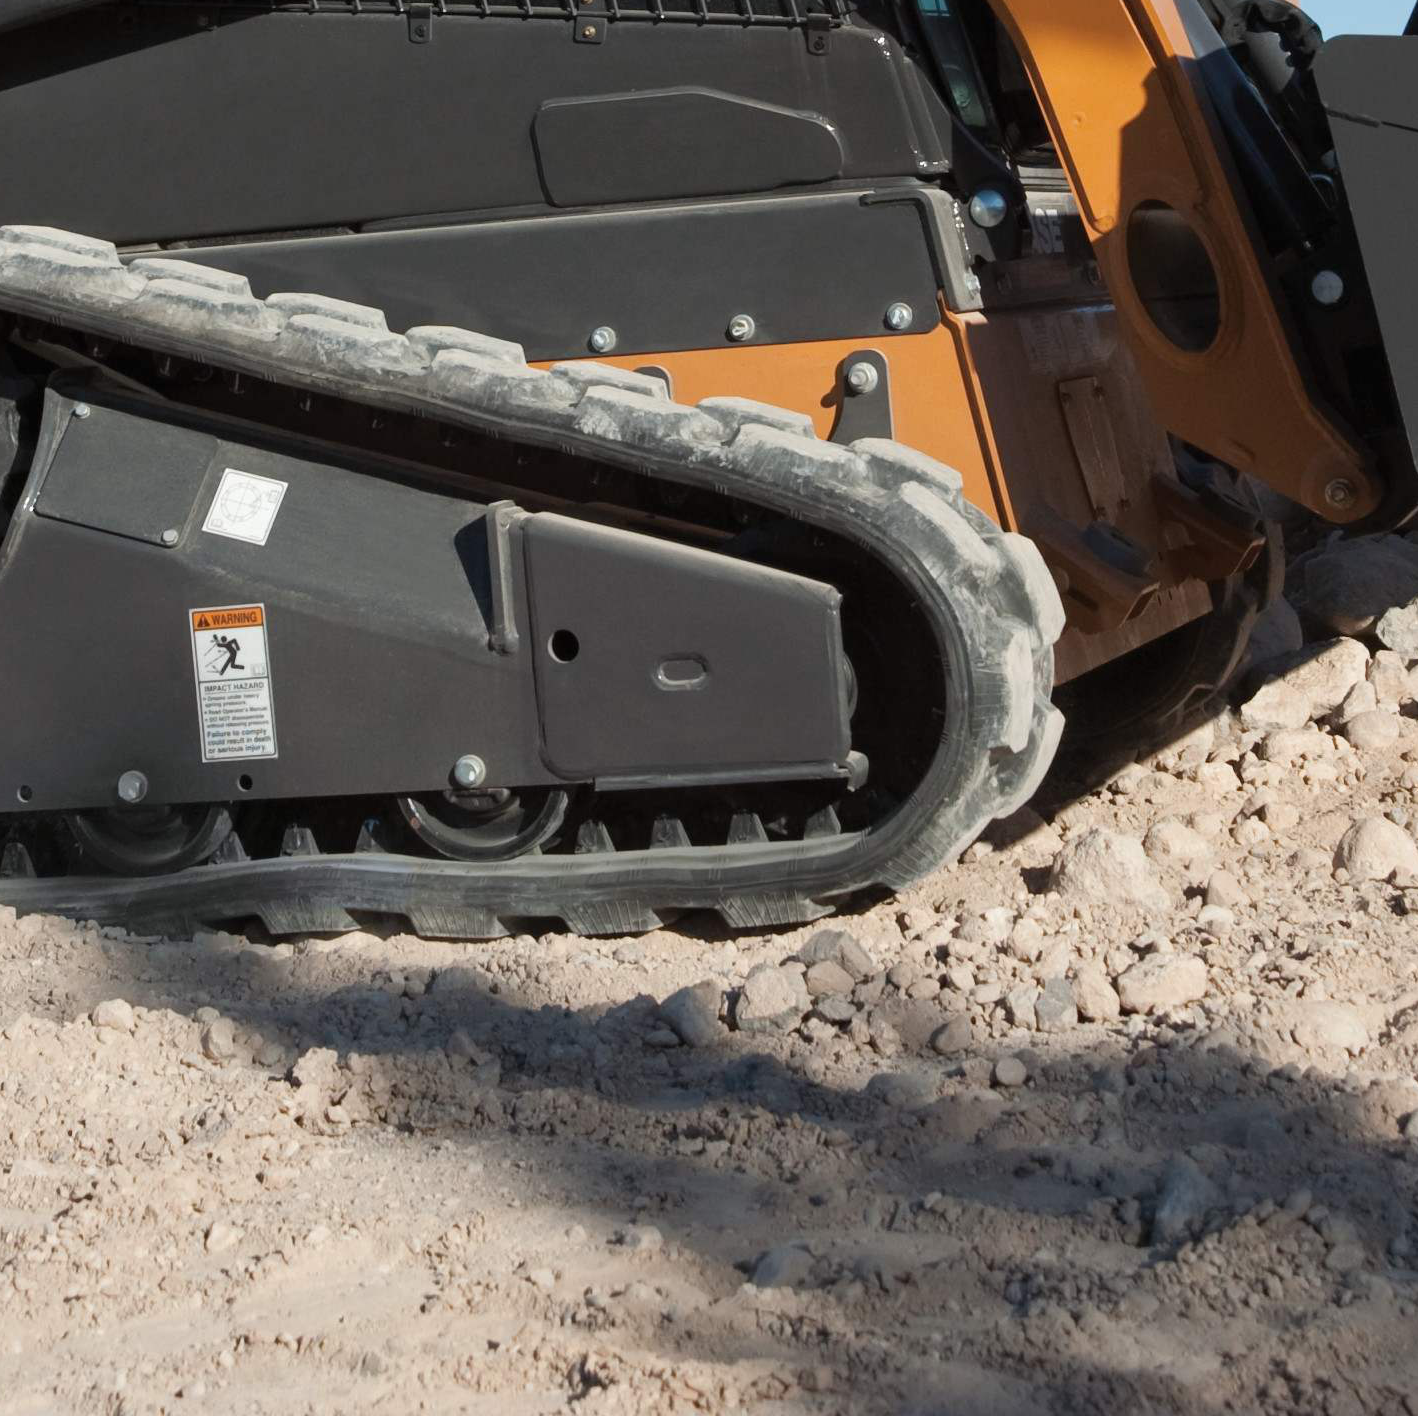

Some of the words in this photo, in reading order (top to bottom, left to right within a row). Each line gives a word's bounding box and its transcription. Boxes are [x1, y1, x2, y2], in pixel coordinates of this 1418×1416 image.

[212, 611, 258, 625] WARNING
[204, 684, 231, 692] IMPACT
[234, 682, 265, 690] HAZARD
[207, 730, 231, 738] Failure
[241, 728, 267, 736] comply
[253, 735, 272, 743] death
